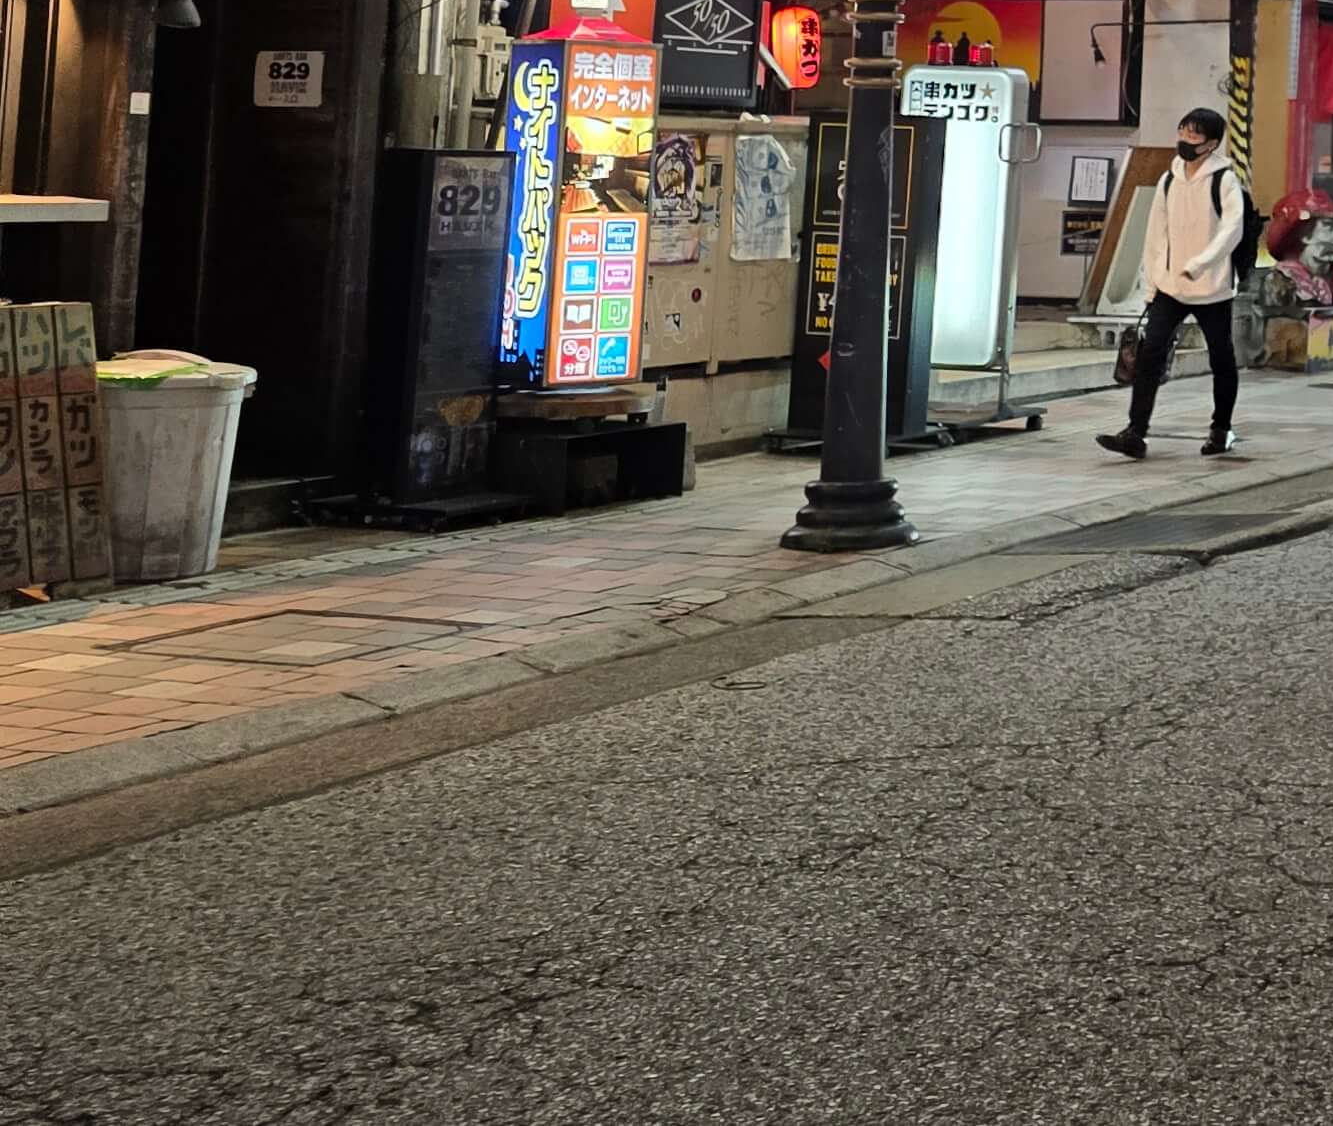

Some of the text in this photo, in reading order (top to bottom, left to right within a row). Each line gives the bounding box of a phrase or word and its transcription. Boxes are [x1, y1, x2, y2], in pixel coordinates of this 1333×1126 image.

[268, 61, 310, 80] 829
[573, 52, 654, 82] 完全個室
[570, 85, 652, 112] インターネット
[924, 81, 977, 100] 串カツ
[437, 184, 501, 217] 829
[518, 62, 557, 316] ナイトパック
[28, 399, 54, 475] カシラ
